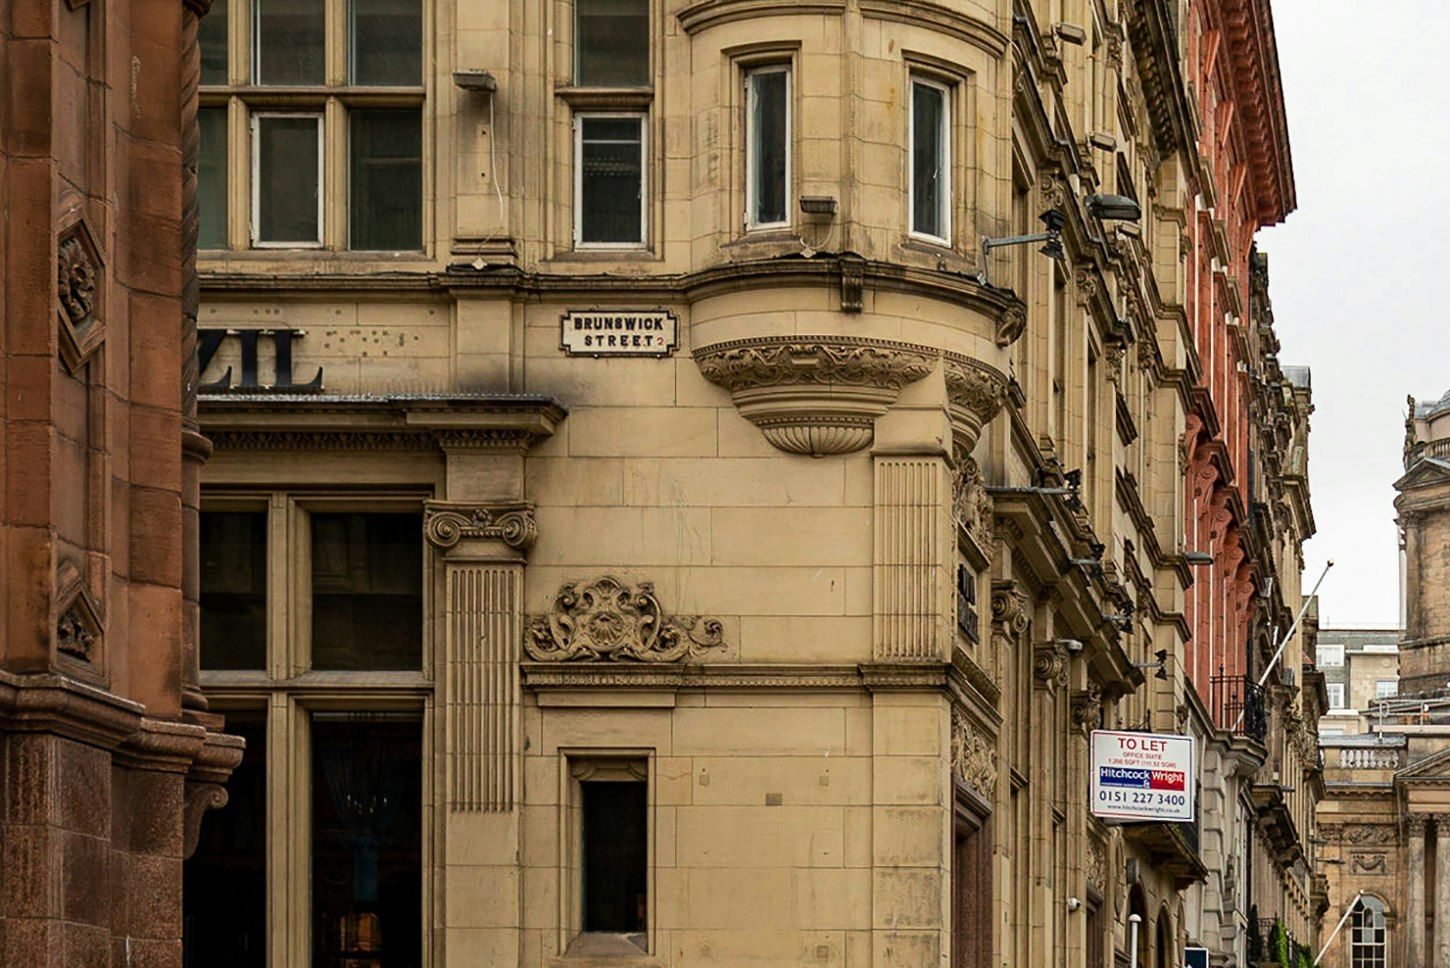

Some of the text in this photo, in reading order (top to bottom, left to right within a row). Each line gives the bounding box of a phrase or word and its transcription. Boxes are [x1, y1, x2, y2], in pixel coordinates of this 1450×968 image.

[573, 317, 663, 330] BRUNSWICK
[584, 335, 664, 346] STREET 2
[1118, 738, 1167, 752] TO LET
[1100, 768, 1184, 784] Hitchcock Wright
[1099, 790, 1185, 806] 0151 227 3400
